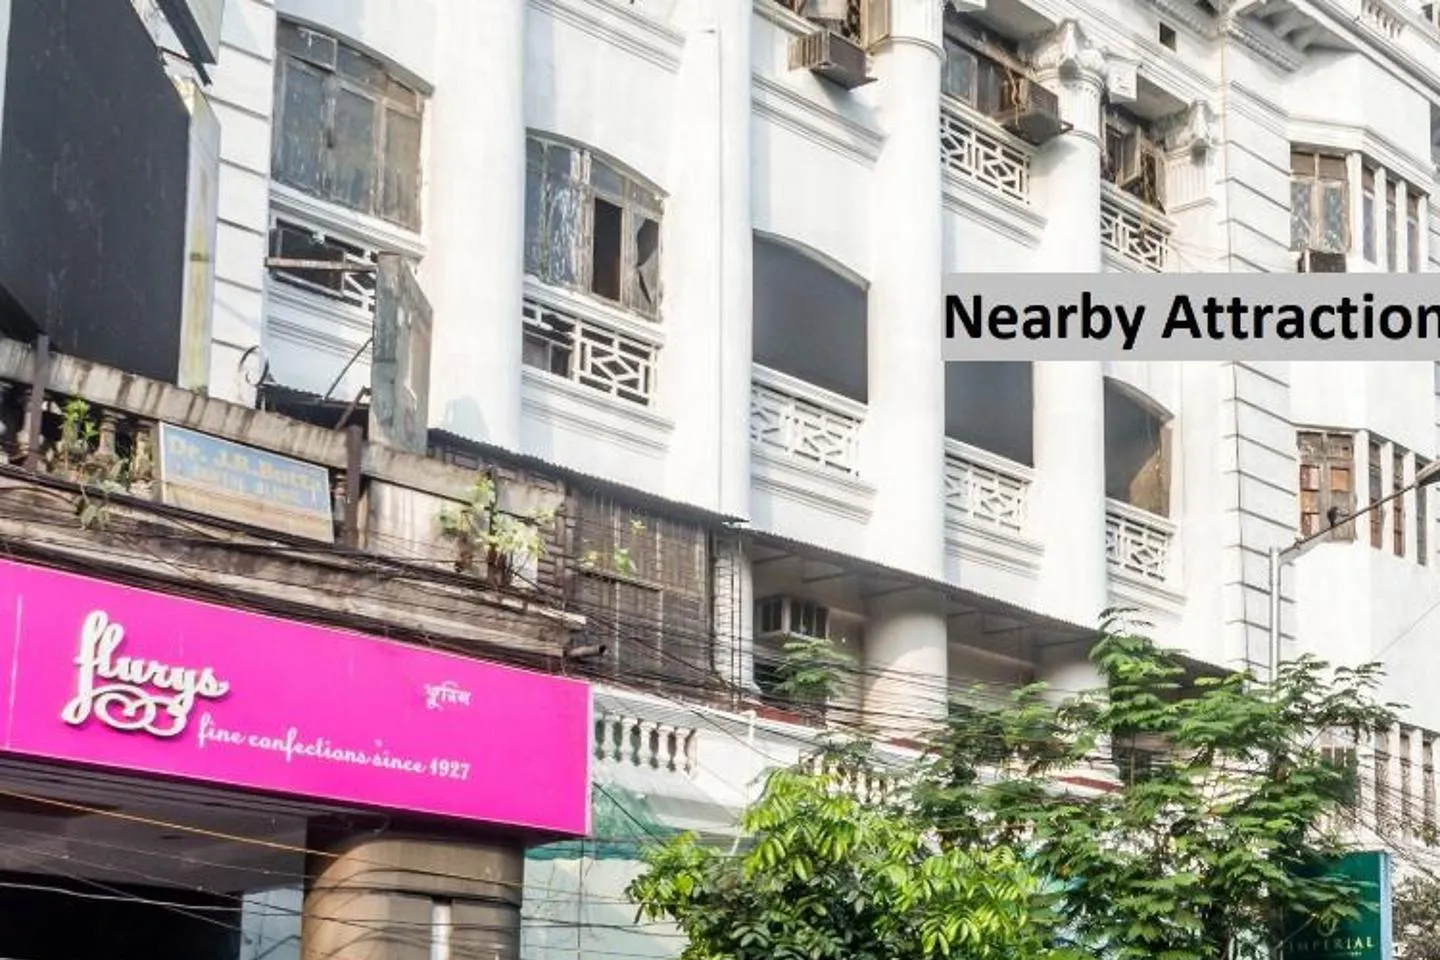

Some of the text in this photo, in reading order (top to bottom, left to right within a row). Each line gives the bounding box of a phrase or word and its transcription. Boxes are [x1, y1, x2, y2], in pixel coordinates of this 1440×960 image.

[61, 610, 230, 736] flurys
[198, 711, 471, 781] fine confections since 1927
